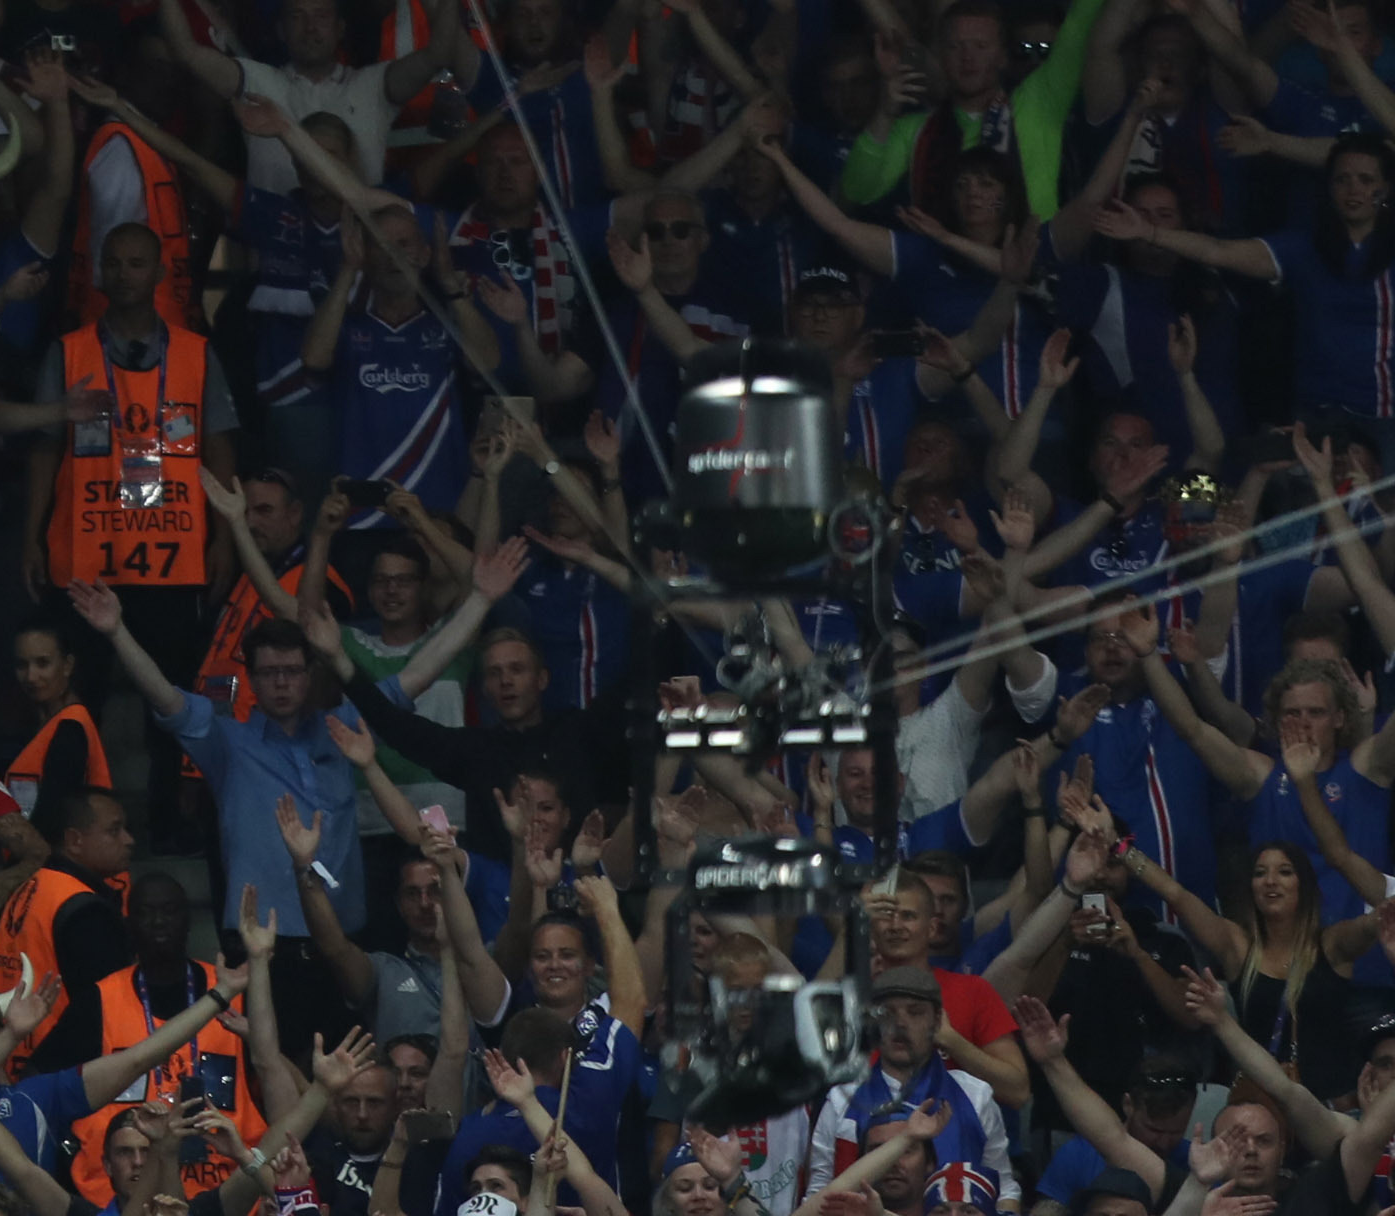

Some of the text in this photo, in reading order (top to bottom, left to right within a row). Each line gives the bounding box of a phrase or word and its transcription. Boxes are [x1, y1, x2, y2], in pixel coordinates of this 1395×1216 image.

[358, 363, 429, 390] Carlsberg
[85, 481, 189, 504] STAER
[80, 509, 194, 534] STEWARD
[97, 541, 181, 578] 147
